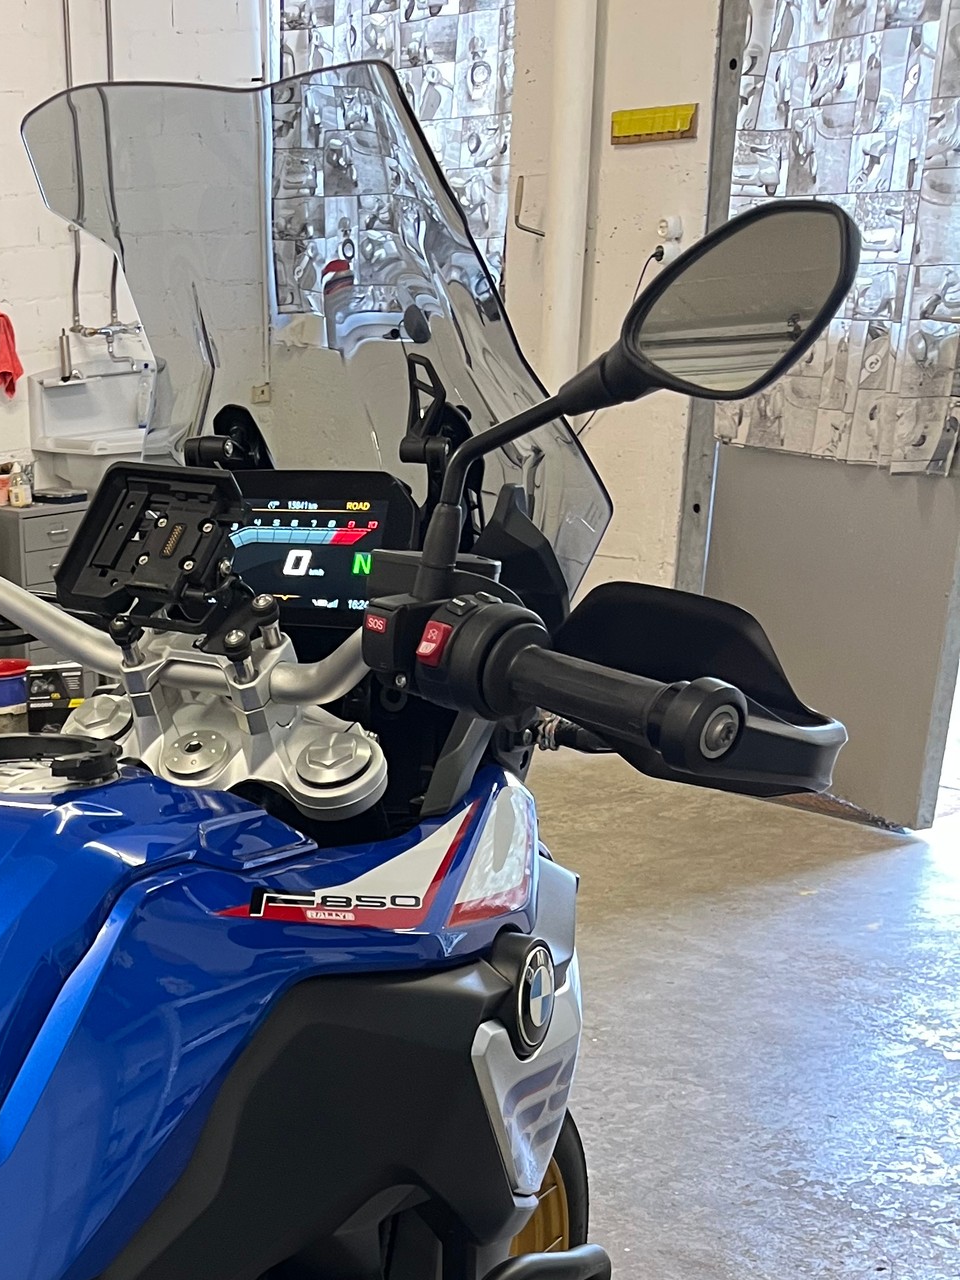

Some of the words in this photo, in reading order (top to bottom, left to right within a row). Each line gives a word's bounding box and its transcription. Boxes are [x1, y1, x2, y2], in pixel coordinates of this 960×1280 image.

[346, 501, 371, 511] ROAD
[253, 518, 262, 527] 4
[272, 519, 281, 527] 5
[290, 519, 299, 528] 6
[310, 519, 318, 528] 7
[347, 521, 356, 529] 9
[367, 521, 379, 529] 10
[282, 549, 313, 576] 0
[352, 551, 372, 575] N
[367, 617, 384, 630] SOS
